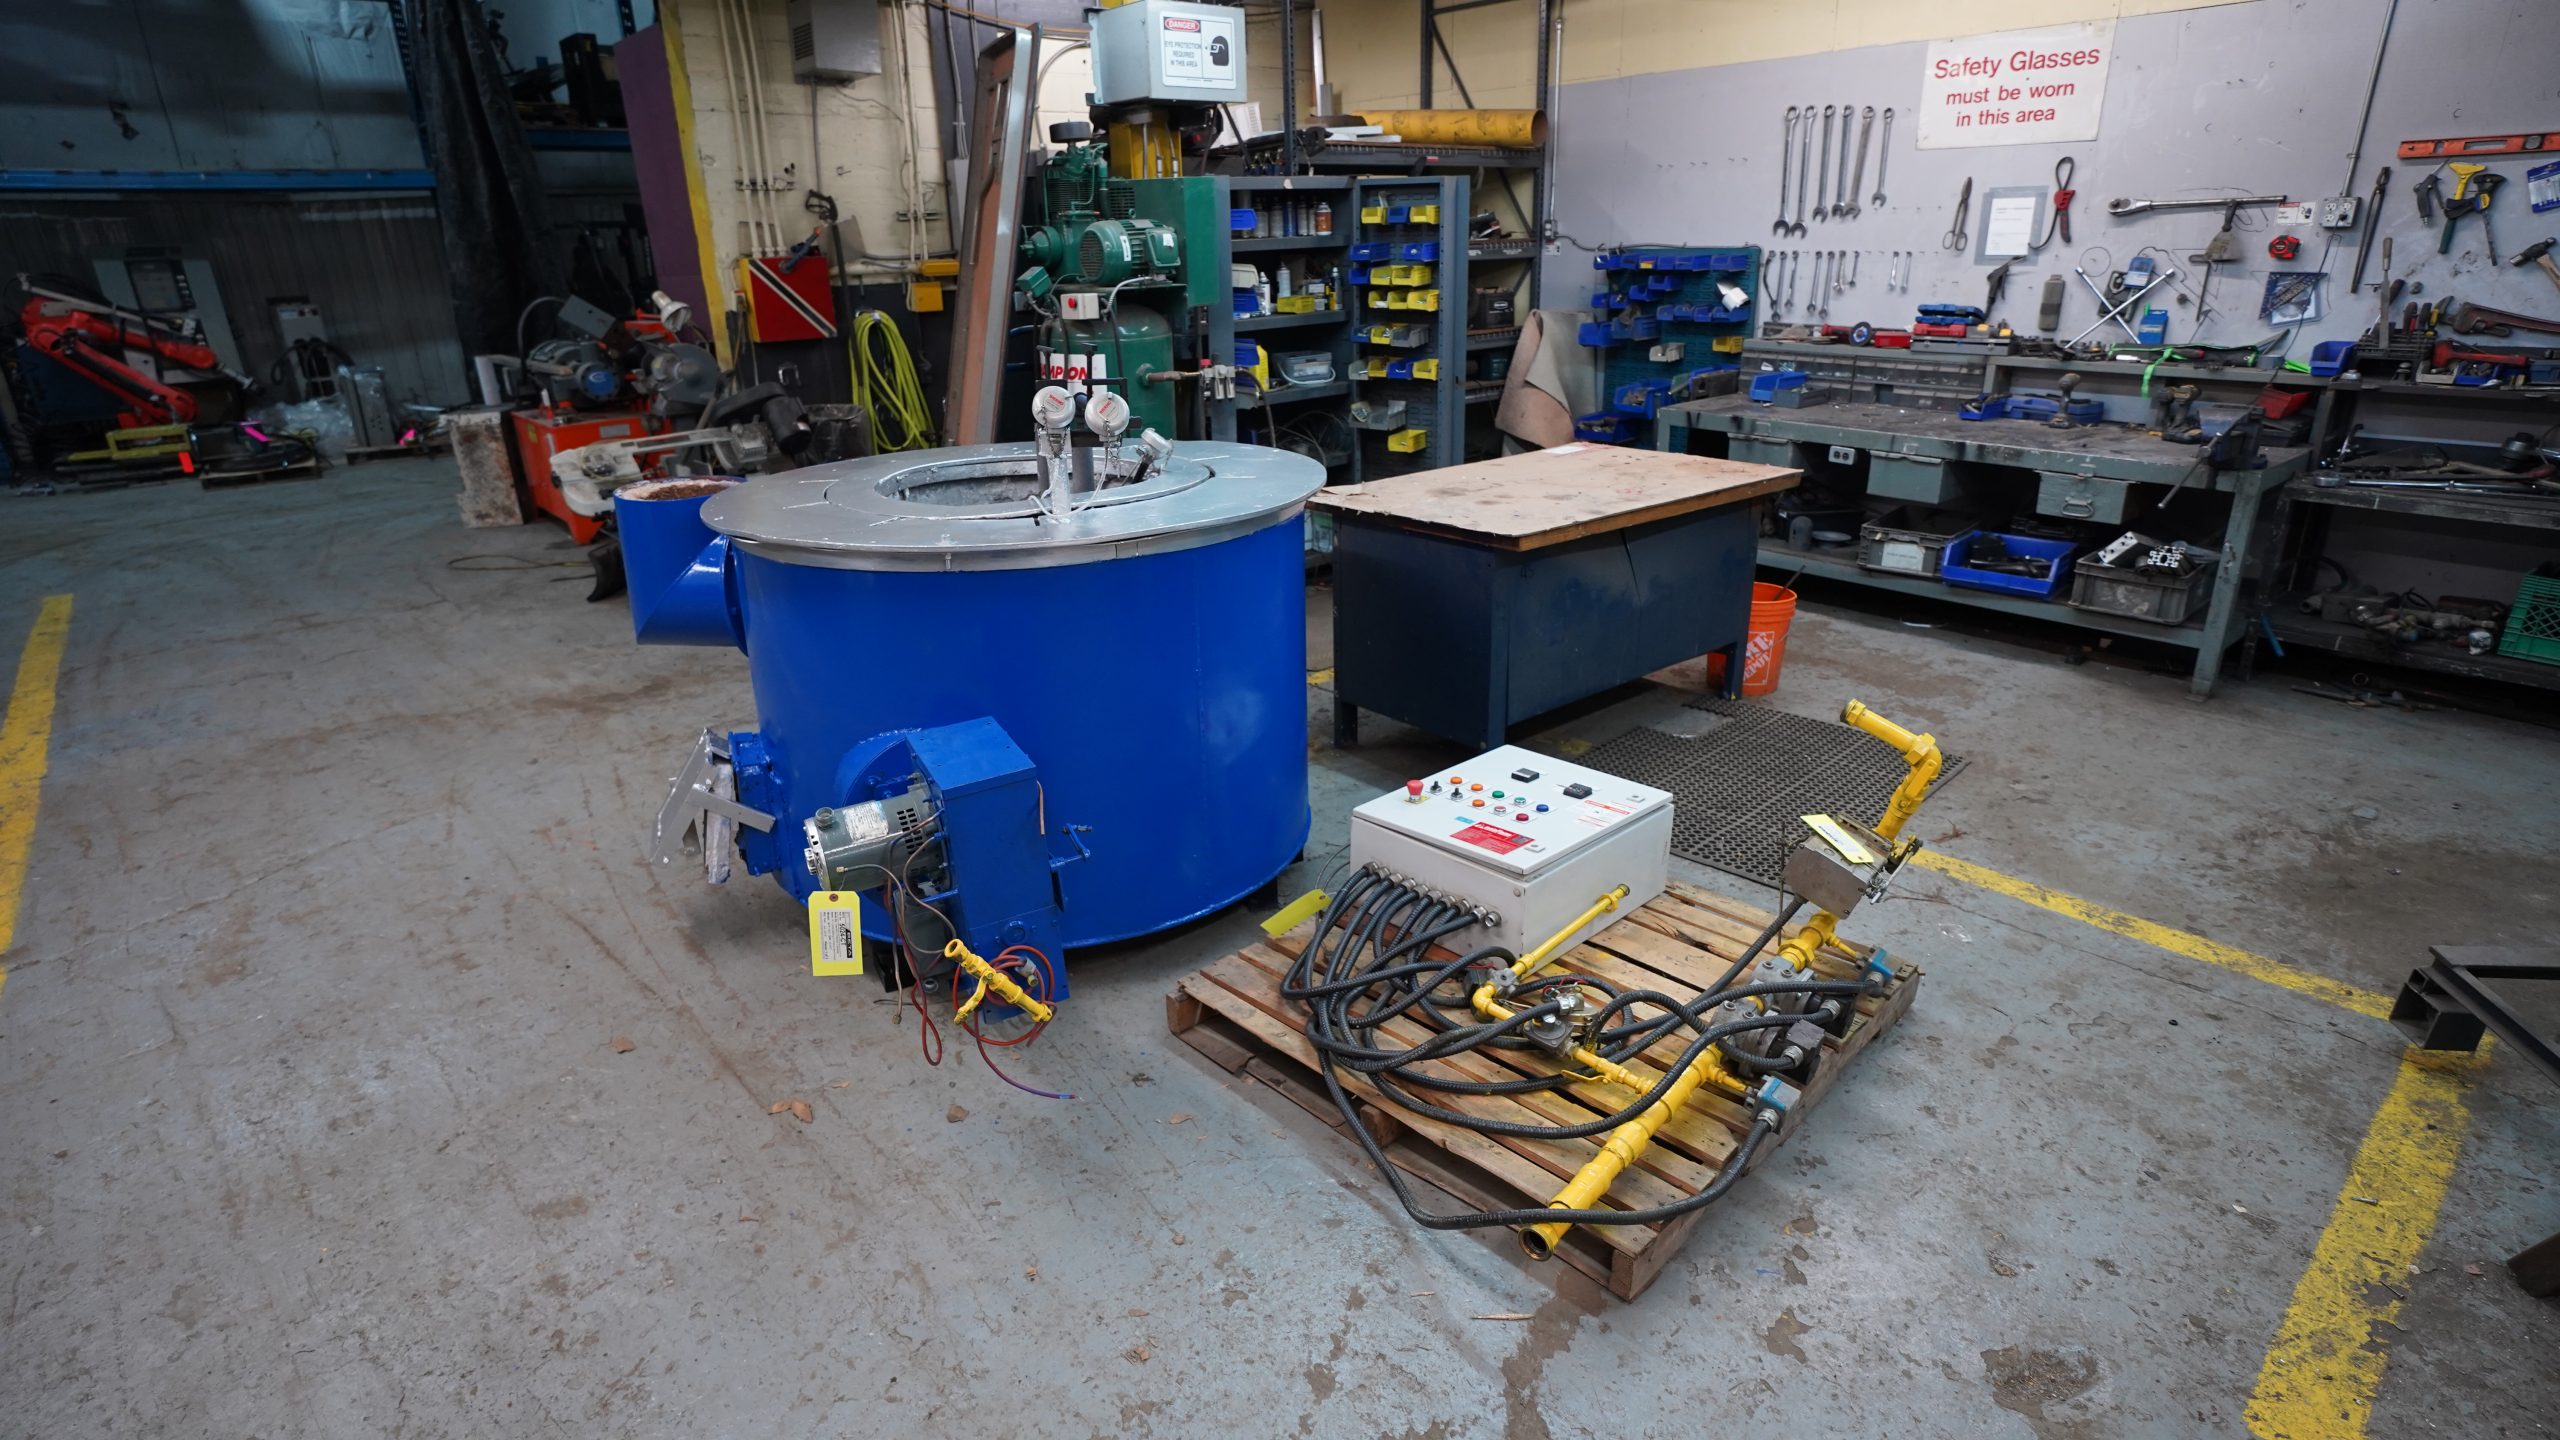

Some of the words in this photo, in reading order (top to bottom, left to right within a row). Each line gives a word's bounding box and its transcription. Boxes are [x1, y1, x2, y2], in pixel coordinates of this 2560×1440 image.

[1168, 20, 1196, 30] DANGER
[1934, 57, 2001, 79] Safety
[2010, 48, 2100, 71] Glasses
[1946, 87, 1989, 105] must
[1998, 85, 2020, 101] be
[2030, 82, 2075, 98] worn
[1956, 110, 1971, 127] in
[1979, 109, 2009, 126] this
[2016, 108, 2056, 123] area
